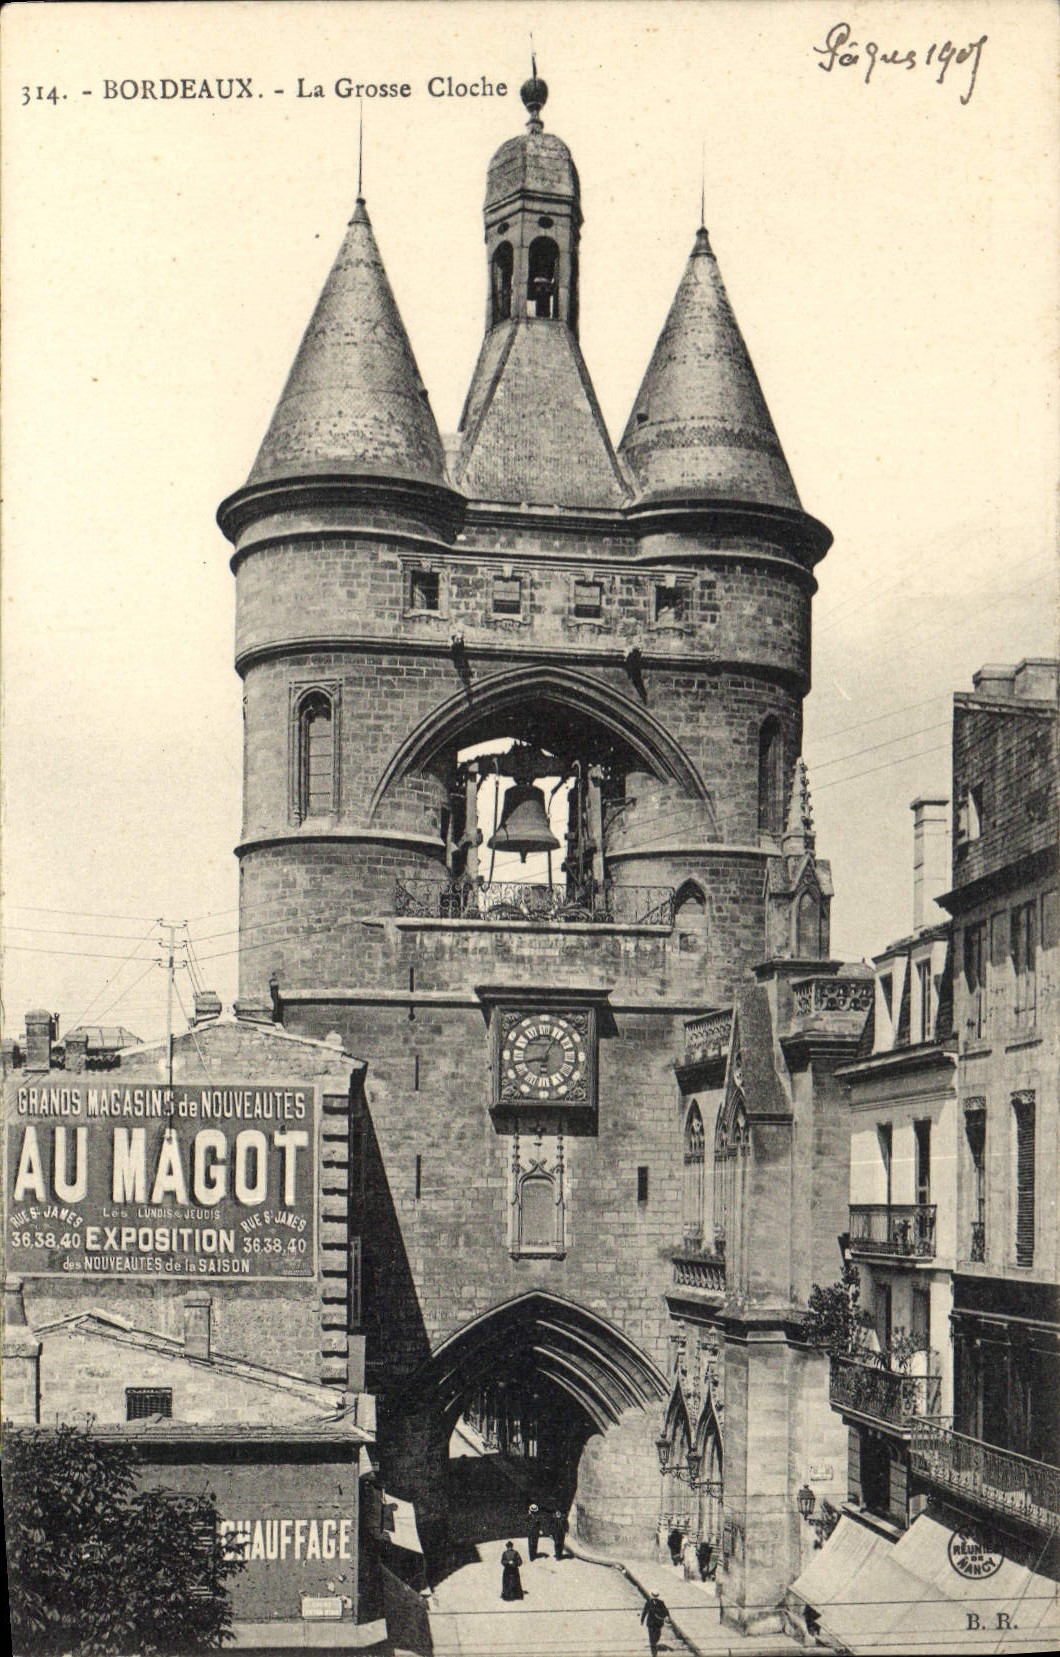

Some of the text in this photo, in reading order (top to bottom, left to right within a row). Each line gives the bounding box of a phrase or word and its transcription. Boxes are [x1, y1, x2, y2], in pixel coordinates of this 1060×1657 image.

[18, 1087, 81, 1116] GRANDS
[87, 1089, 174, 1117] MAGASINS
[178, 1093, 198, 1118] de
[13, 1126, 309, 1207] AU MAGOT
[10, 1210, 30, 1229] RUE
[43, 1205, 84, 1228] JAMES
[102, 1207, 128, 1218] Les
[137, 1208, 173, 1219] LUNDIS
[184, 1208, 221, 1220] JEUDIS
[240, 1213, 263, 1234] RUE
[274, 1211, 307, 1233] JAMES
[85, 1226, 235, 1253] EXPOSITION
[63, 1256, 82, 1270] des
[165, 1258, 181, 1272] de
[185, 1258, 196, 1273] la
[198, 1258, 250, 1273] SAISON
